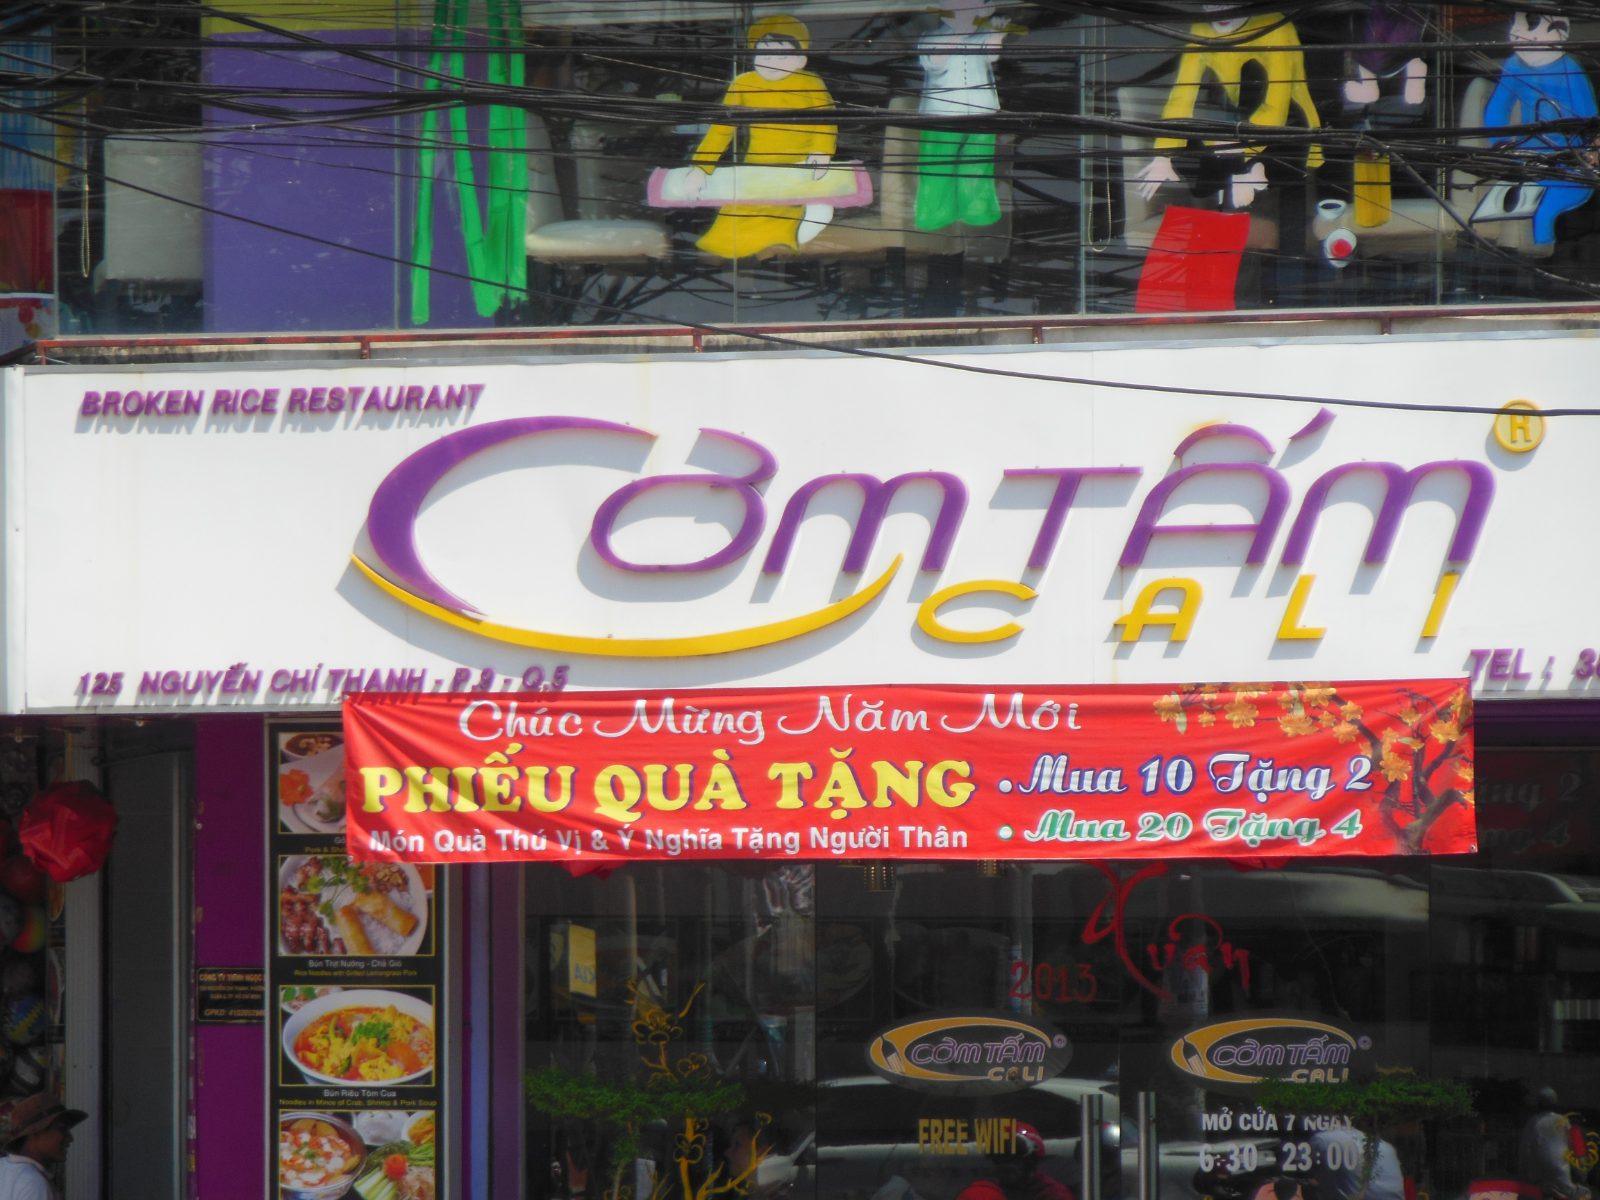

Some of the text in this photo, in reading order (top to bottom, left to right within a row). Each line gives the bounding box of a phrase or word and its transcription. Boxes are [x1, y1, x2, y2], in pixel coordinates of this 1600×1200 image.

[80, 383, 486, 417] BROKEN RICE RESTAURANT
[1002, 407, 1497, 568] TẤM
[917, 571, 1461, 643] CALI
[79, 671, 125, 696] 125
[270, 662, 324, 693] CHÍ
[328, 667, 429, 692] THANH
[1470, 648, 1533, 682] TEL
[458, 692, 1082, 746] Chúc Mừng Năm Mới
[359, 742, 976, 823] PHIẾU QUÀ TẶNG
[1018, 752, 1373, 803] Mua 10 Tặng 2
[369, 823, 969, 856] Món Quà Thú Vị & Ý Nghĩa Tặng Người Thân
[1023, 807, 1364, 847] Mua 20 Tặng 4
[1008, 961, 1098, 1003] 2013
[1291, 1067, 1350, 1084] CALI
[918, 1117, 1018, 1156] FREE WIFI
[1284, 1114, 1296, 1132] 7
[1200, 1142, 1259, 1173] 6:30
